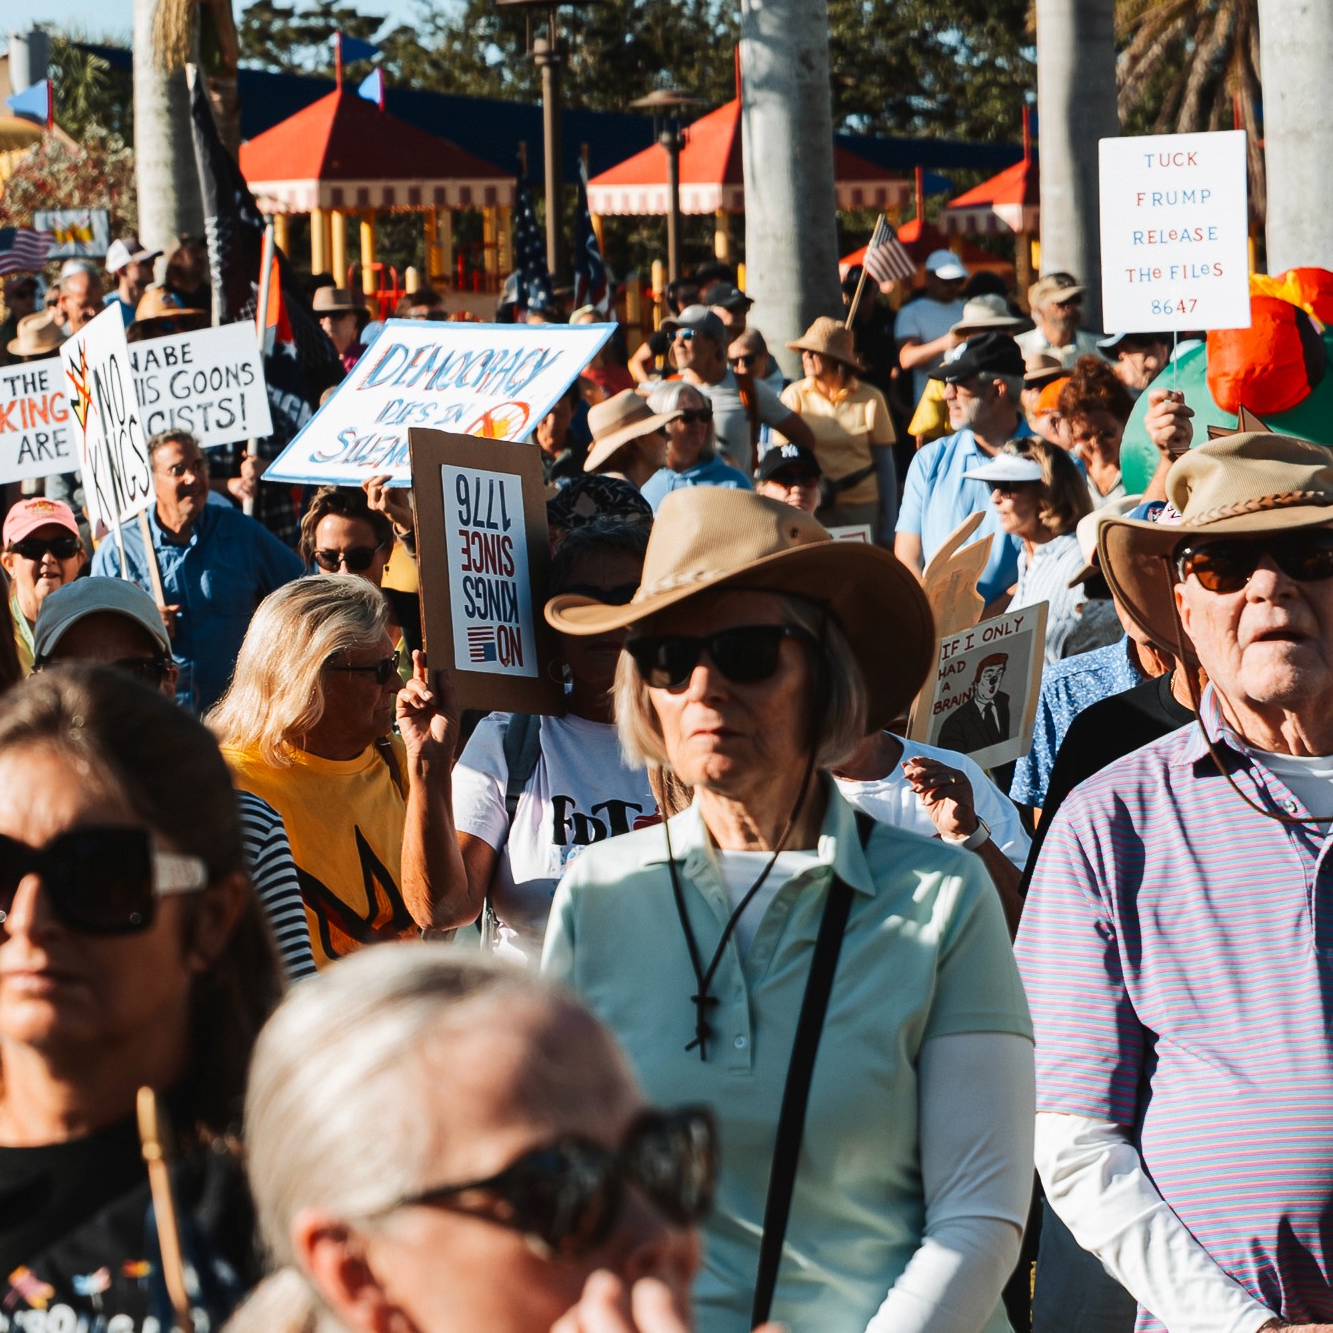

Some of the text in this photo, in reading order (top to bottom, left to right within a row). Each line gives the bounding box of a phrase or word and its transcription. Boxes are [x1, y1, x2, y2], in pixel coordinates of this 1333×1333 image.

[1144, 151, 1198, 168] TUCK
[1136, 189, 1211, 207] FRUMP
[1151, 299, 1198, 315] 8647
[3, 369, 50, 397] THE
[169, 362, 256, 400] GOONS
[356, 342, 565, 398] DEMOCRACY
[92, 353, 126, 436] NO
[375, 398, 475, 426] DIES IN
[17, 428, 70, 465] ARE
[88, 413, 151, 522] KINGS
[455, 473, 512, 532] 1776
[458, 529, 515, 578] SINCE
[462, 575, 520, 624] KINGS
[496, 624, 524, 667] NO
[941, 616, 1024, 661] IF I ONLY
[937, 660, 967, 682] HAD
[941, 681, 951, 693] A
[550, 795, 643, 846] FDT
